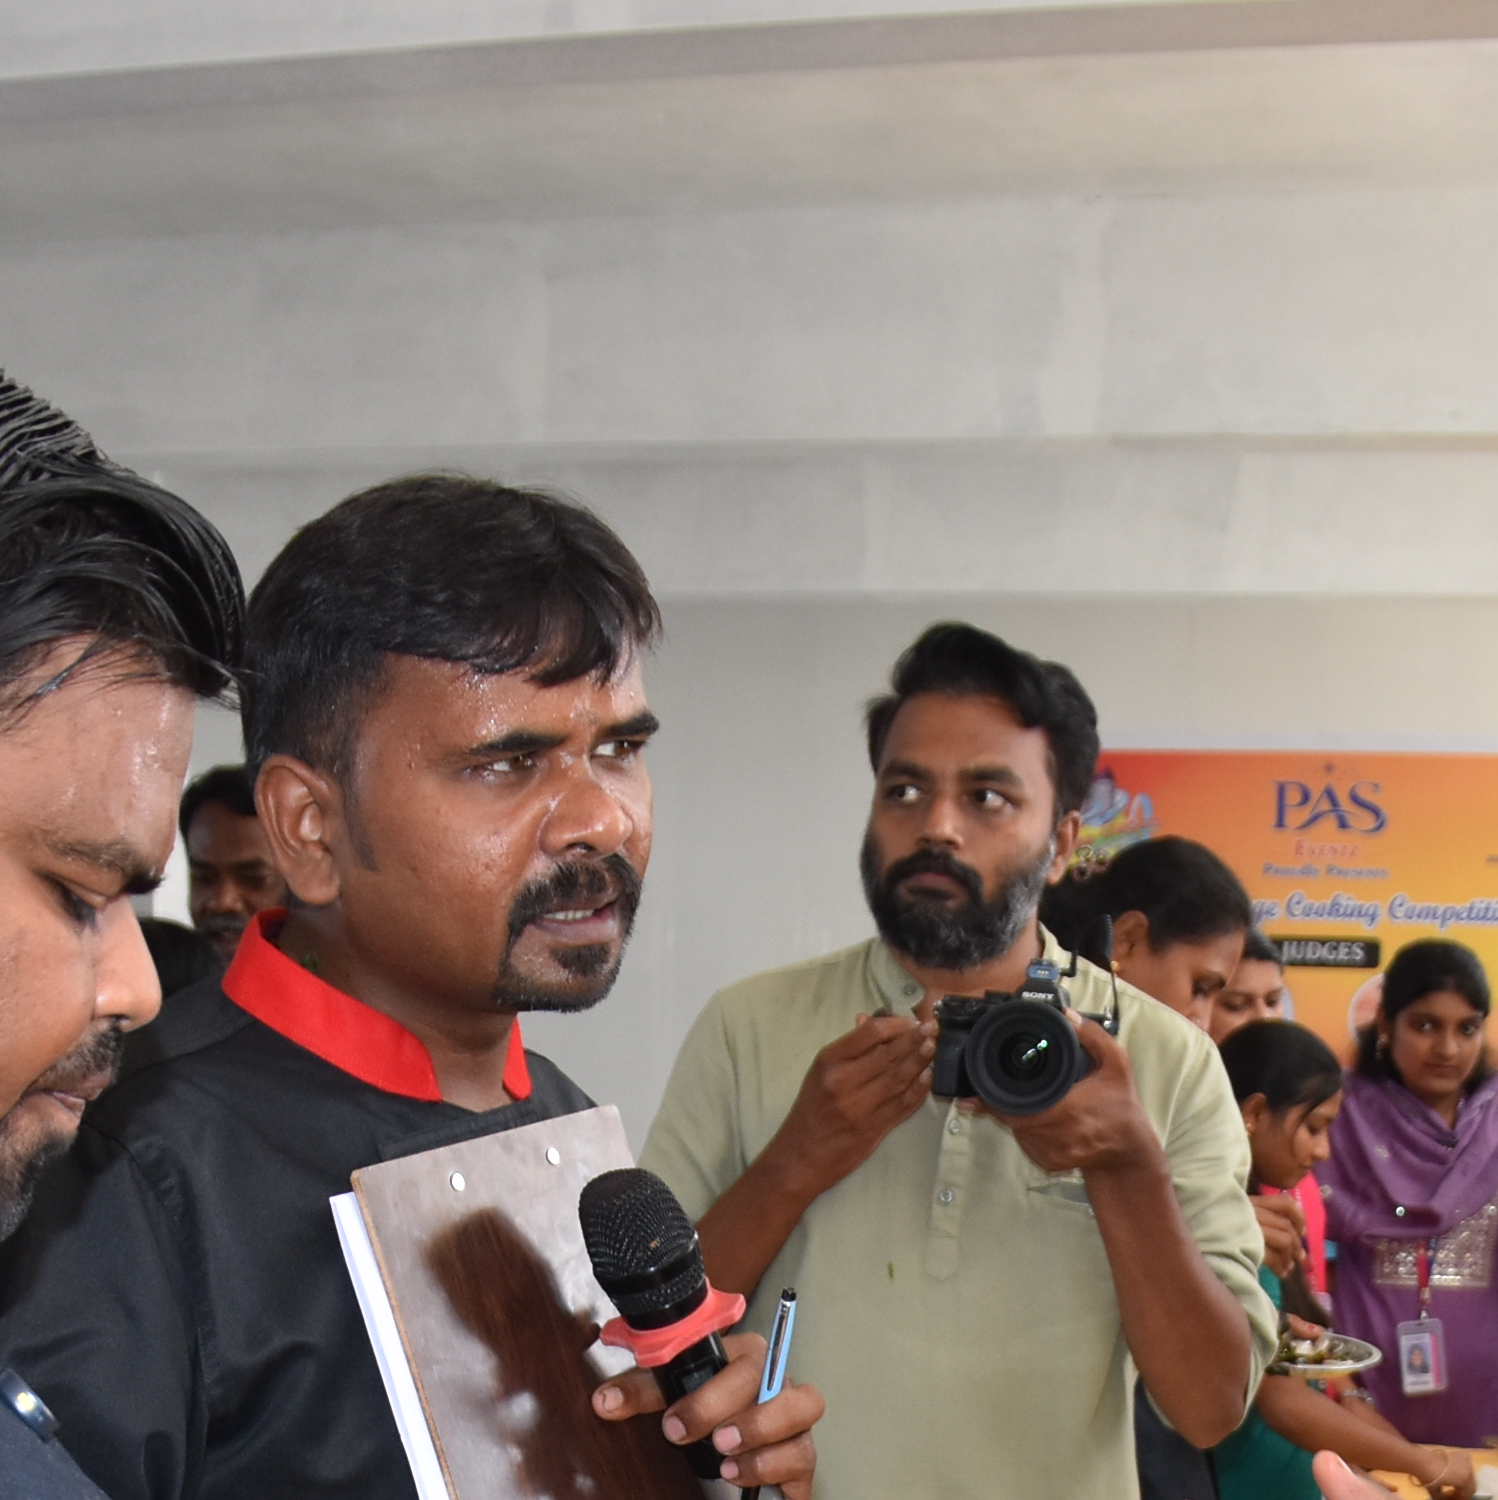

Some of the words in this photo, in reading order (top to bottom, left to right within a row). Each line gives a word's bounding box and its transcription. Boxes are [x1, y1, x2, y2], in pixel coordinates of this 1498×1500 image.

[1270, 780, 1387, 833] PAS
[1286, 890, 1380, 929] Cooking
[1281, 941, 1365, 961] JUDGES
